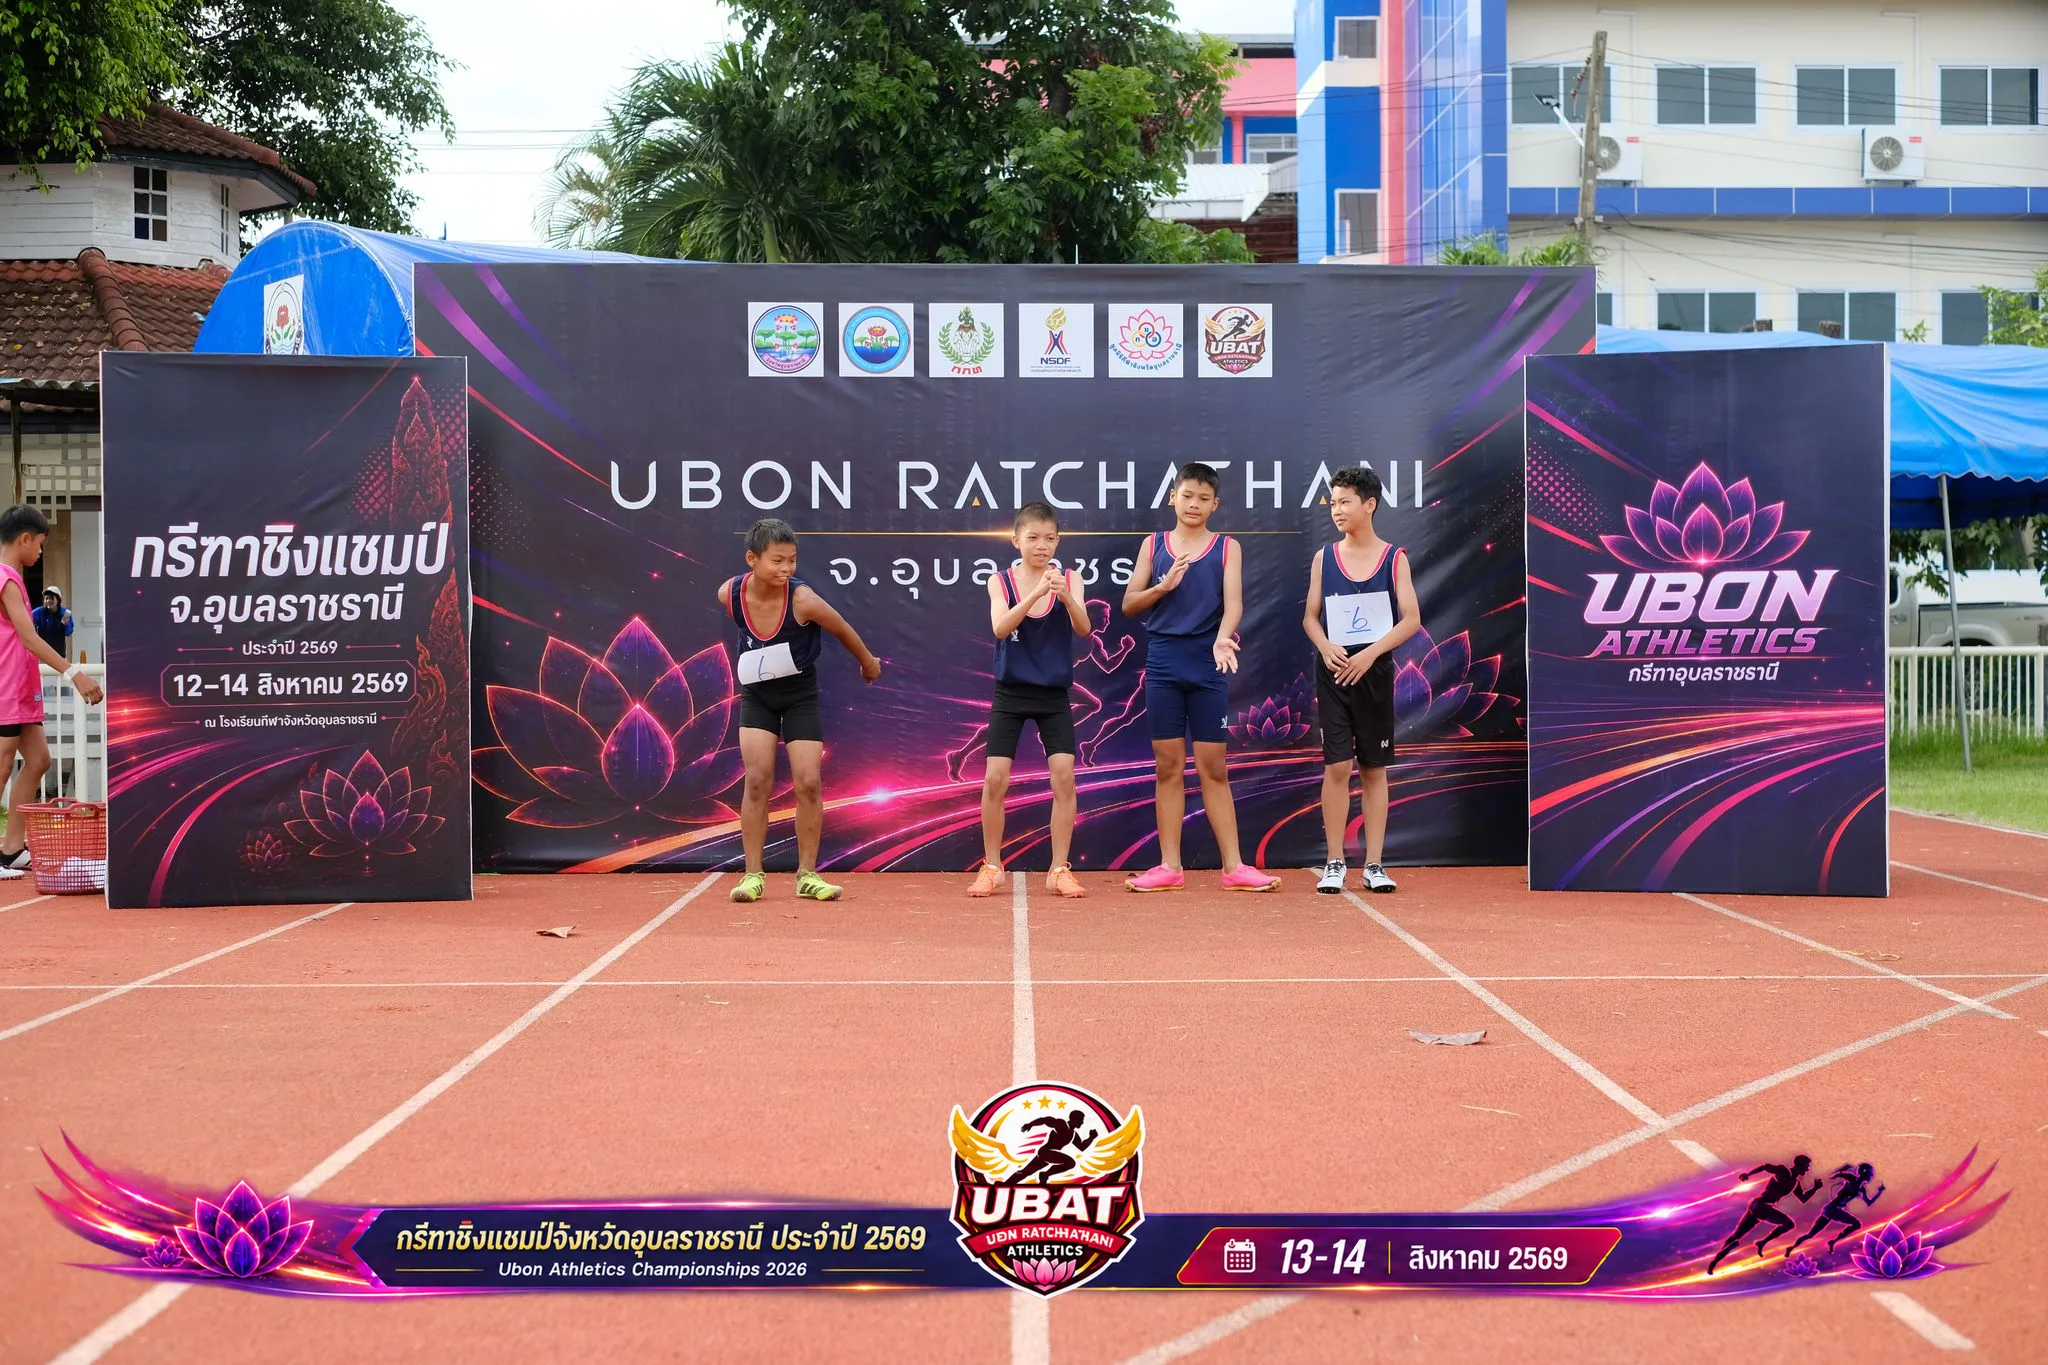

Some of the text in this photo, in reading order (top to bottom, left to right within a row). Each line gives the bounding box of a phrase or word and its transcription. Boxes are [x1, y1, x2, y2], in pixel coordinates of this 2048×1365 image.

[1210, 341, 1261, 355] UBAT
[951, 365, 983, 375] กกท
[1040, 357, 1071, 365] NSDF
[610, 460, 851, 510] UBON
[131, 521, 449, 578] กรีฑาชิงแชมป์
[170, 583, 405, 634] จ.อุบลราชธานี
[1583, 569, 1840, 624] UBON
[1352, 606, 1369, 630] 6
[242, 640, 338, 656] ประจำปี 2569
[1590, 627, 1830, 656] ATHLETICS
[257, 672, 344, 696] สิงหาคม
[352, 671, 409, 695] 2569
[1628, 661, 1780, 687] กรีฑาอุบลราชธานี
[204, 717, 217, 729] ณ
